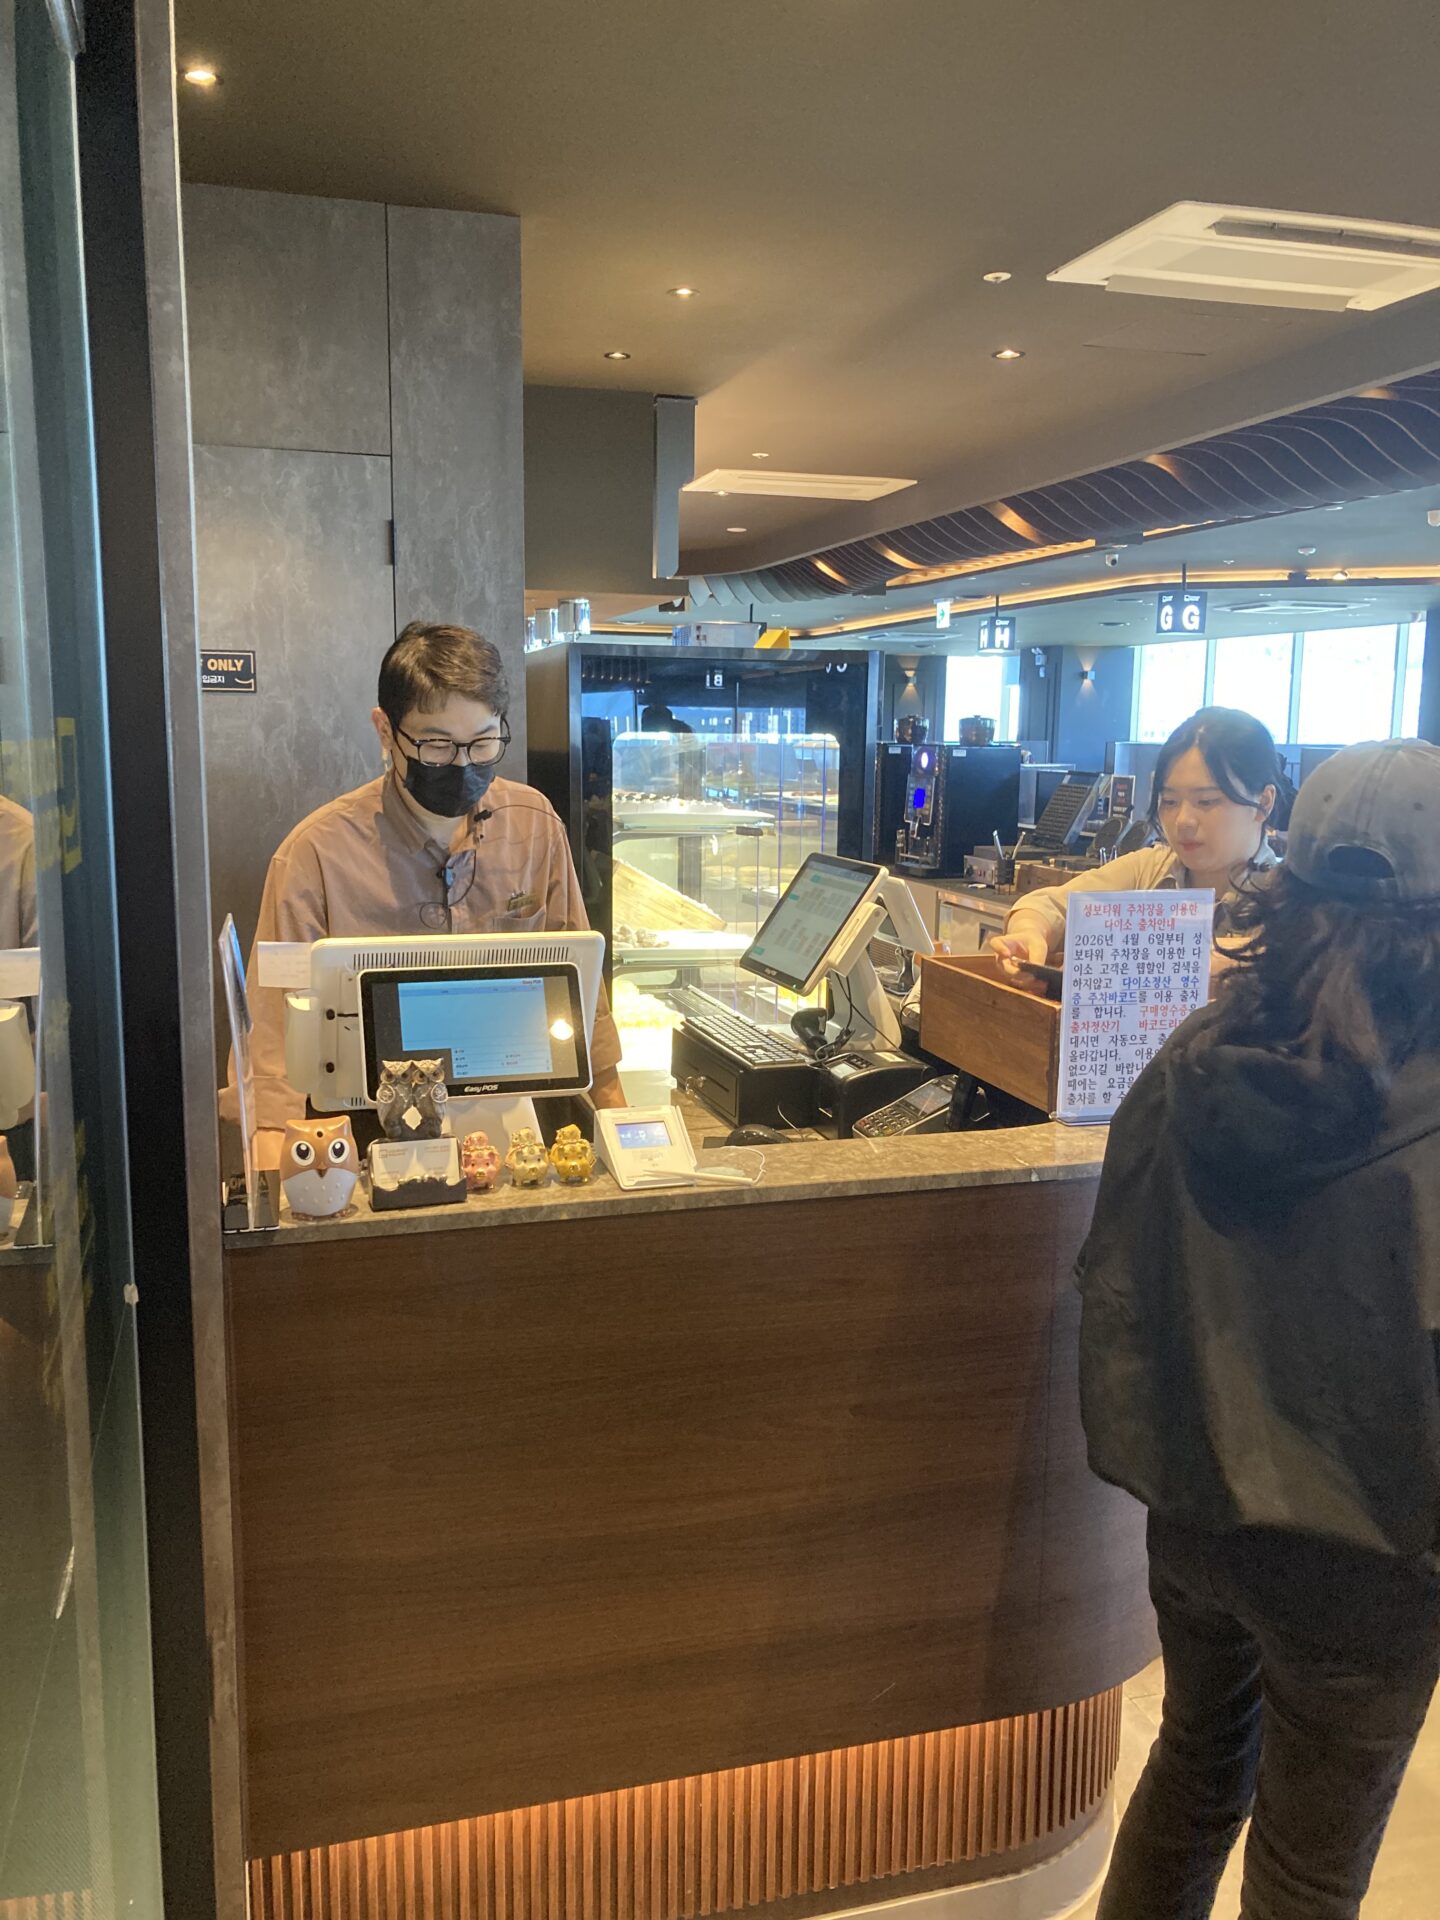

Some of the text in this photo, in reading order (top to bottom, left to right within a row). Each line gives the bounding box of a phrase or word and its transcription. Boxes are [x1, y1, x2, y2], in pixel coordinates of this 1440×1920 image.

[1160, 604, 1200, 631] G G
[980, 627, 1010, 649] H H
[207, 658, 244, 671] ONLY
[202, 674, 225, 684] 입금지
[1083, 902, 1198, 917] 성보타워 주차장을 이용한
[1104, 917, 1176, 931] 다이소 출차안내
[1075, 932, 1202, 947] 2026년 4월 6일부터 성
[1074, 946, 1202, 961] 보타워 주차장을 이용한 다
[1073, 960, 1200, 976] 이소 고객은 웹할인 검색을
[1072, 975, 1200, 991] 하지않고 다이소정산 영수
[1088, 990, 1147, 1005] 주차바코드를
[1154, 990, 1173, 1003] 이용
[1180, 989, 1199, 1003] 출차
[1071, 1007, 1080, 1019] 를
[1094, 1005, 1127, 1019] 합니다.
[1070, 1020, 1120, 1034] 출차정산기
[1070, 1035, 1099, 1048] 대시면
[1108, 1034, 1148, 1048] 자동으로
[1069, 1049, 1122, 1062] 올라갑니다.
[1068, 1062, 1147, 1077] 없으시길 바랍니
[1067, 1078, 1097, 1091] 때에는
[1067, 1092, 1096, 1105] 출차를
[1102, 1091, 1112, 1104] 할
